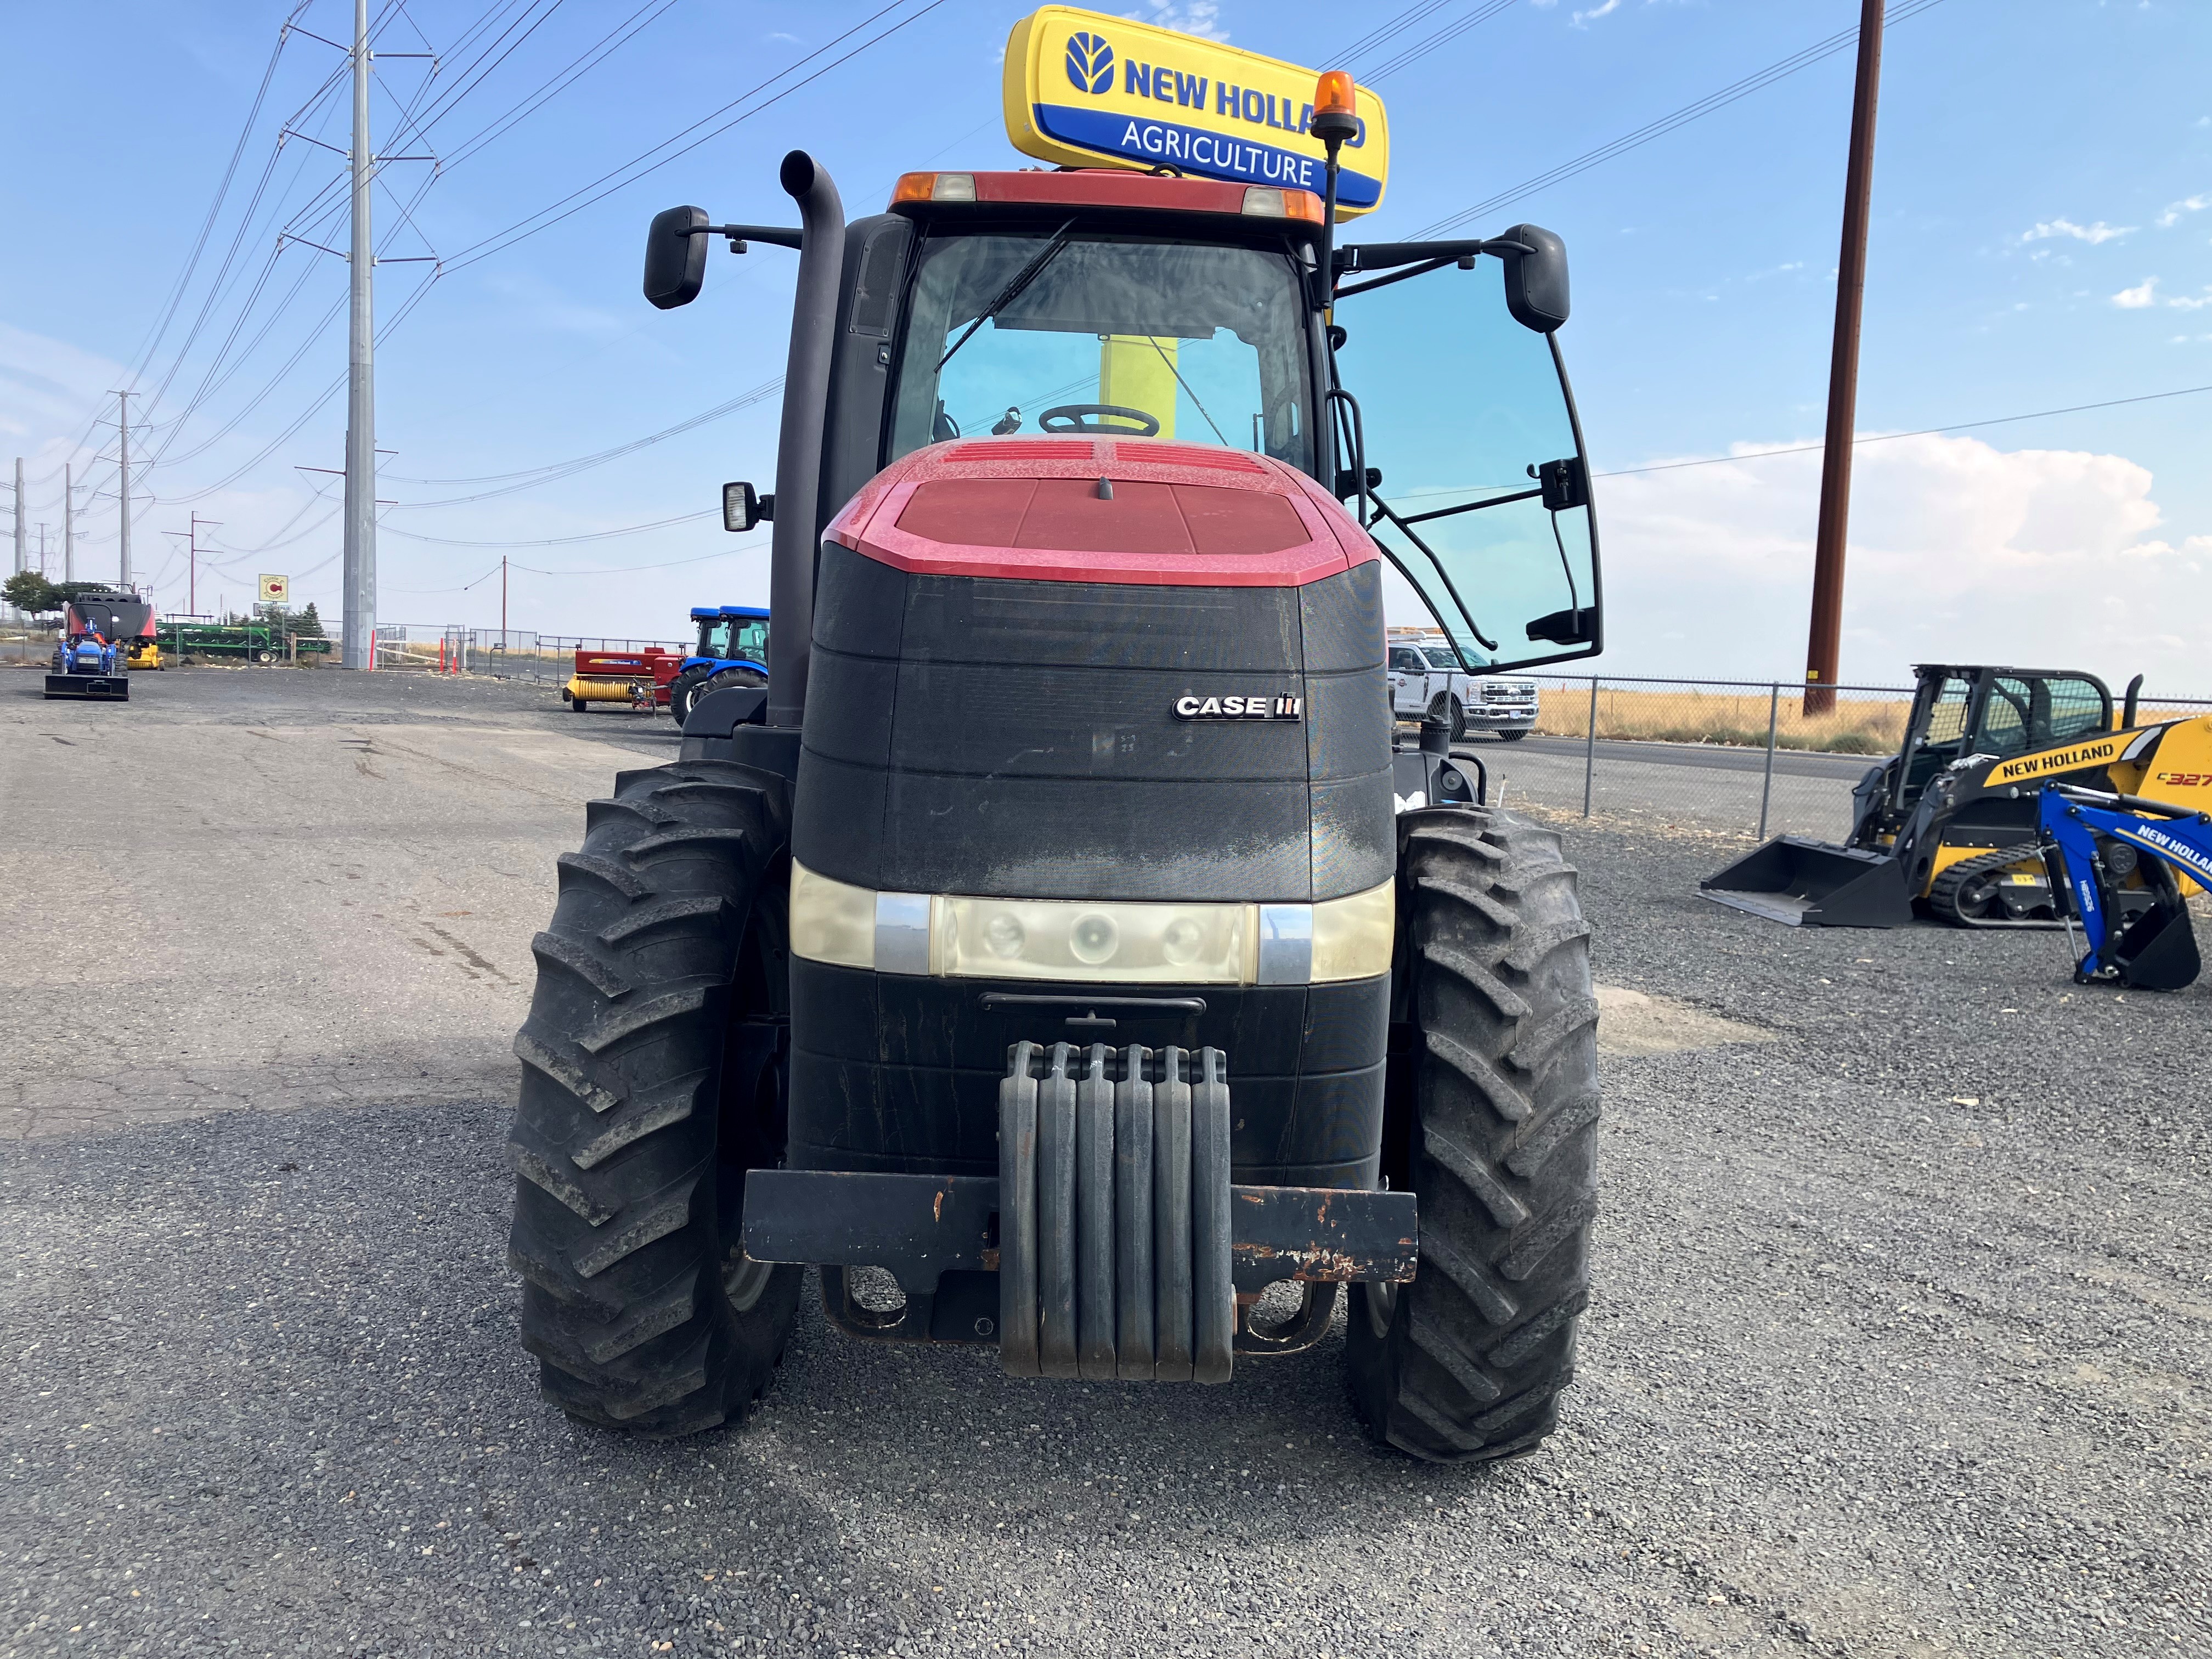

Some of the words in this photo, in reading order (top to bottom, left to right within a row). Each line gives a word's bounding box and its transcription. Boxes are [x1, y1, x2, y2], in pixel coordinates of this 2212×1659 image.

[1125, 59, 1207, 110] NEW
[1217, 81, 1366, 148] HOLLAD
[1121, 121, 1313, 187] AGRICULTURE
[1176, 696, 1266, 715] CASE
[2003, 759, 2038, 777] NEW
[2042, 744, 2114, 769] HOLLAND
[2137, 824, 2171, 846] NEW
